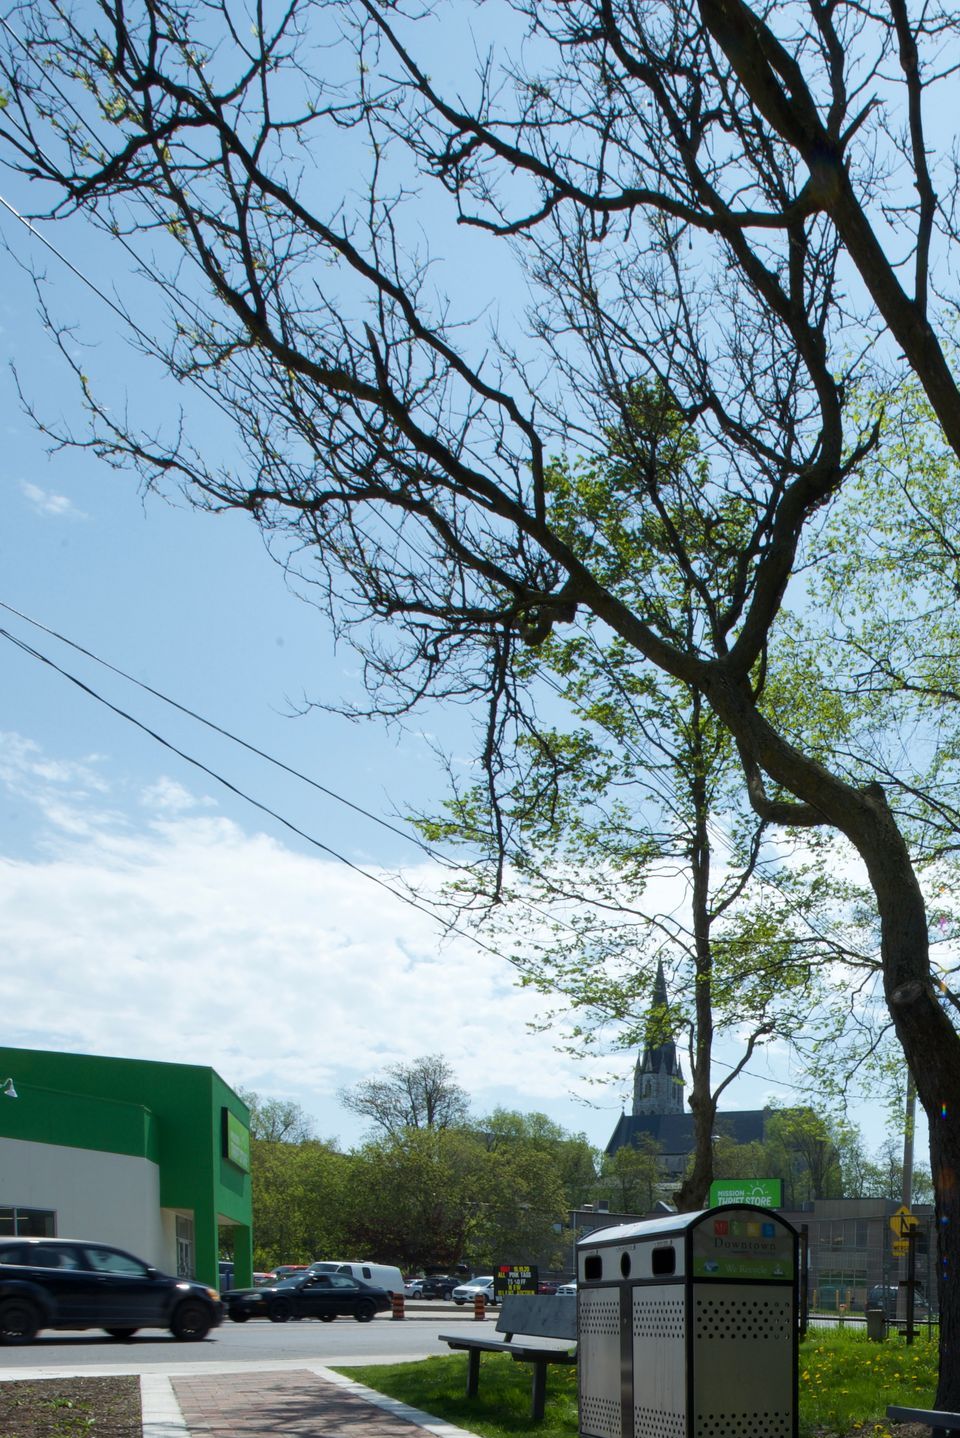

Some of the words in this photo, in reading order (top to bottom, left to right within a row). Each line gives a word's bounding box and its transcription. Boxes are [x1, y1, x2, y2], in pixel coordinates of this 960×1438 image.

[717, 1197, 745, 1206] THRIFT
[745, 1196, 772, 1206] STORE
[714, 1237, 777, 1250] Downtown
